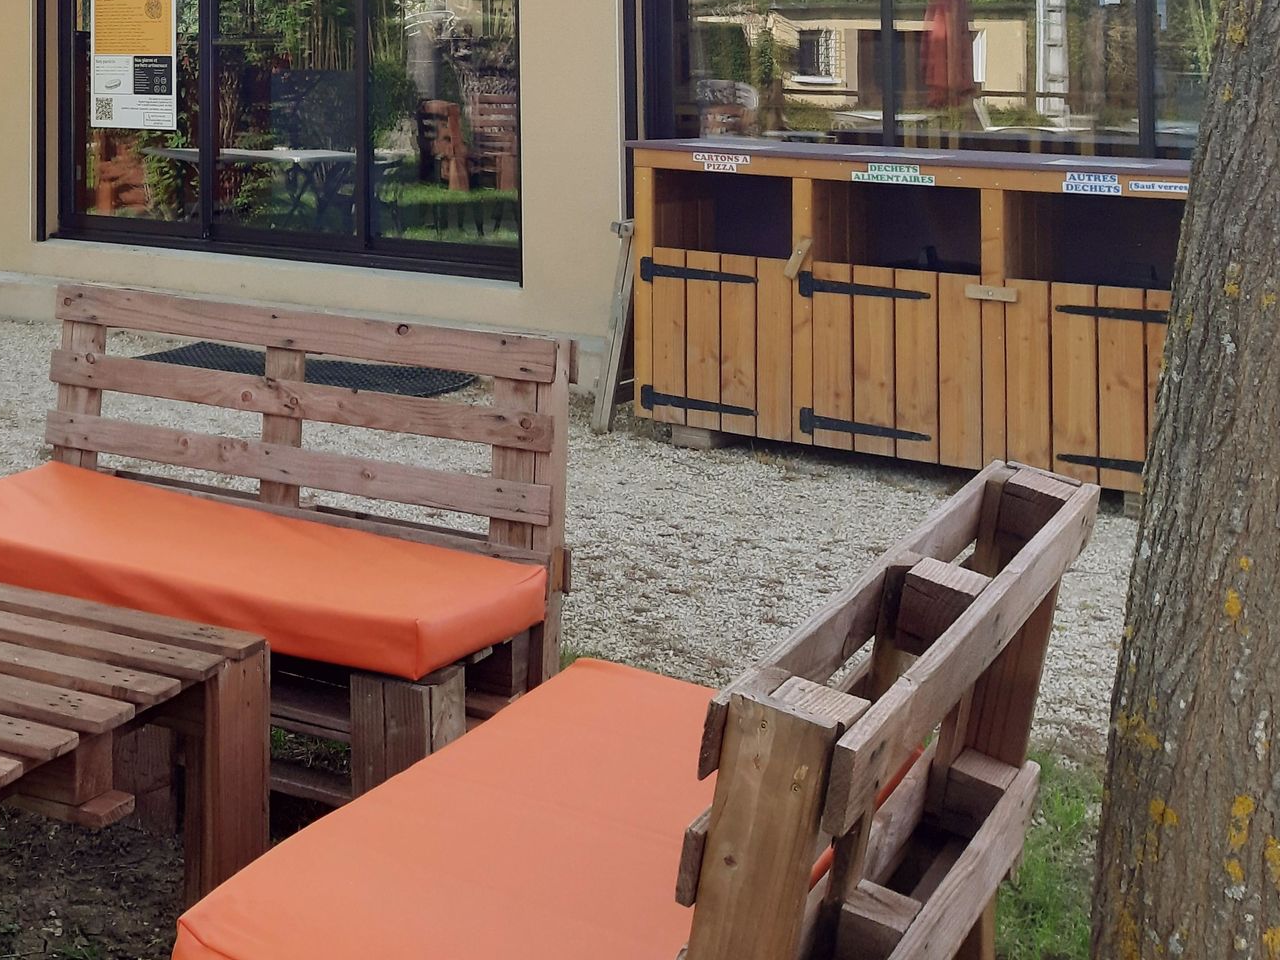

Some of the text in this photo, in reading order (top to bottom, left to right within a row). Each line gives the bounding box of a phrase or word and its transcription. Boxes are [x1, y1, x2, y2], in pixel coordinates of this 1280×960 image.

[694, 154, 740, 163] CARTONS
[706, 163, 735, 172] PIZZA
[869, 164, 919, 174] DECHETS
[853, 173, 934, 184] ALIMENTAIRES
[1068, 173, 1117, 183] AUTRES
[1065, 183, 1121, 193] DECHETS
[1129, 182, 1155, 192] (Sauf
